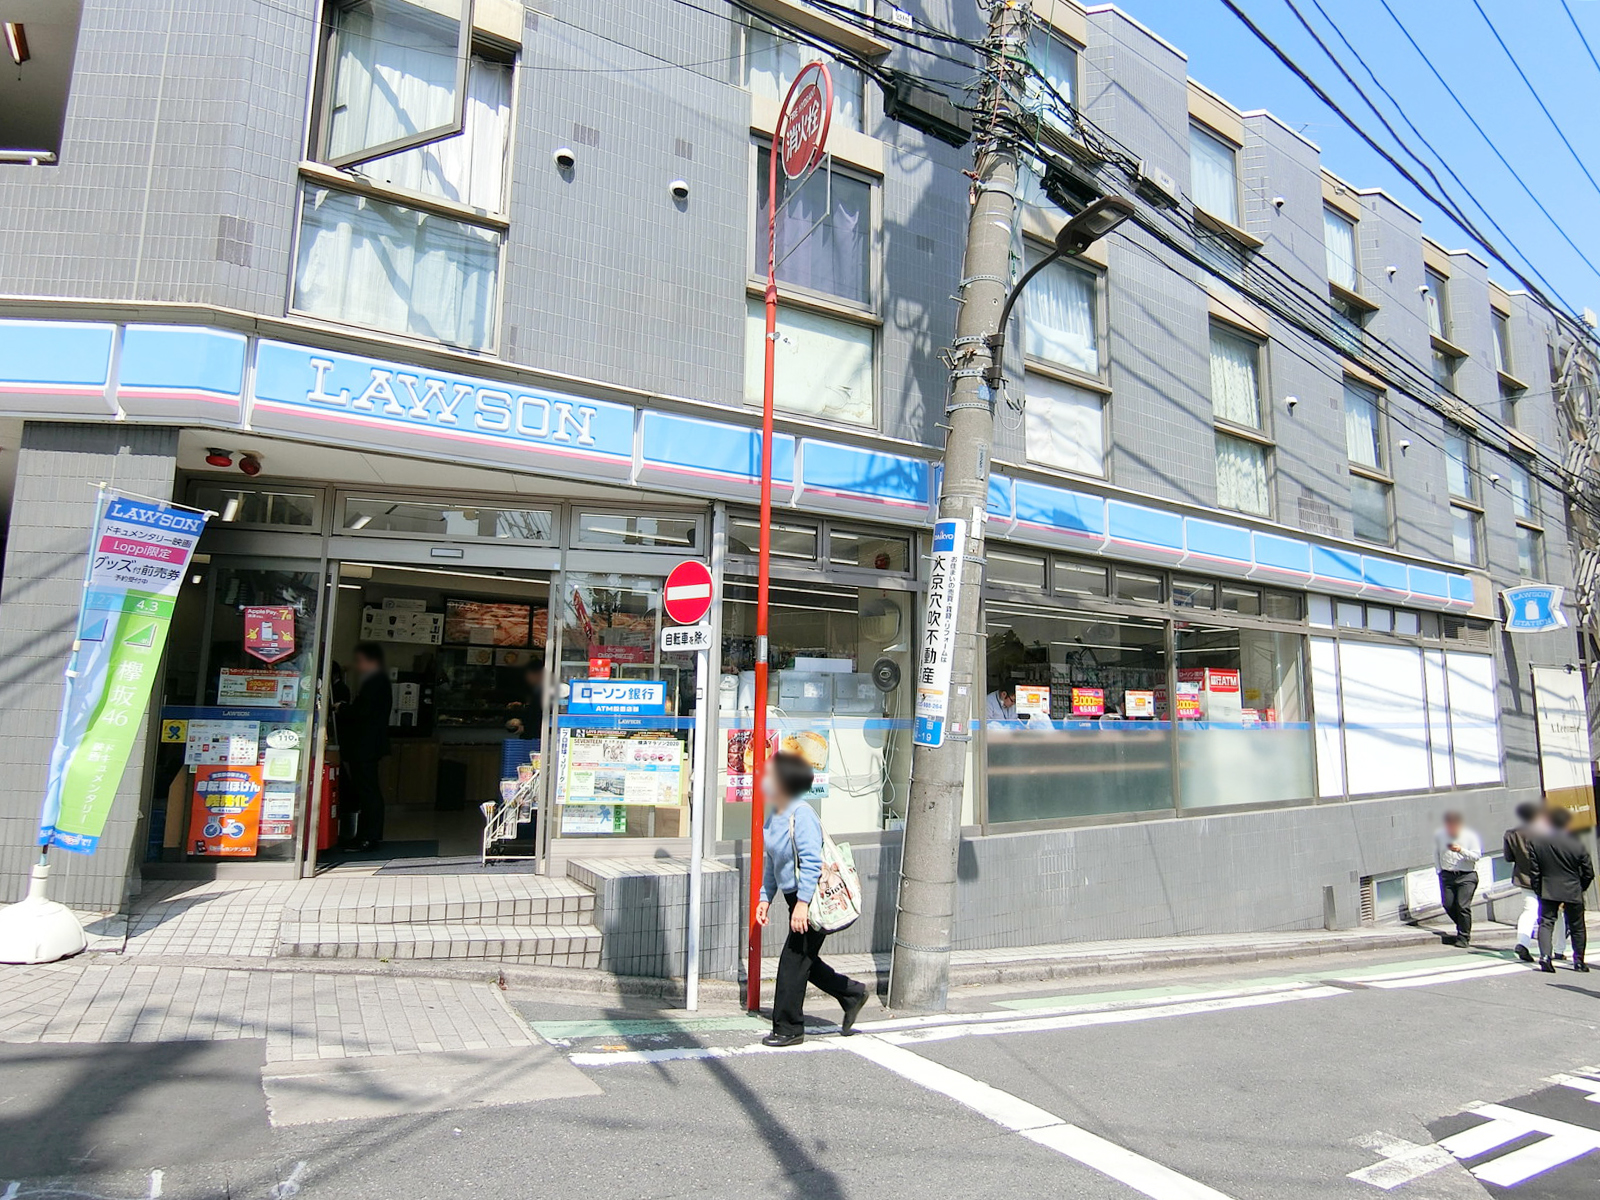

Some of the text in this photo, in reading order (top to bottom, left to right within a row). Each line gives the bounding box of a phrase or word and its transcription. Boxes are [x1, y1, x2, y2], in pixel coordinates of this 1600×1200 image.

[786, 99, 820, 162] 消火栓
[307, 356, 598, 446] LAWSON
[111, 504, 201, 532] LAWSON
[105, 526, 193, 548] ドキュメンタリー映画
[113, 541, 172, 560] Loppi限定
[94, 556, 181, 581] グッズ付前売券
[136, 599, 159, 612] 4.3
[1512, 591, 1551, 601] LAWSON
[921, 555, 946, 685] 大京穴吹不動産
[1513, 617, 1553, 627] STATION
[666, 631, 708, 646] 自転車を除く
[581, 687, 655, 701] ローソン銀行
